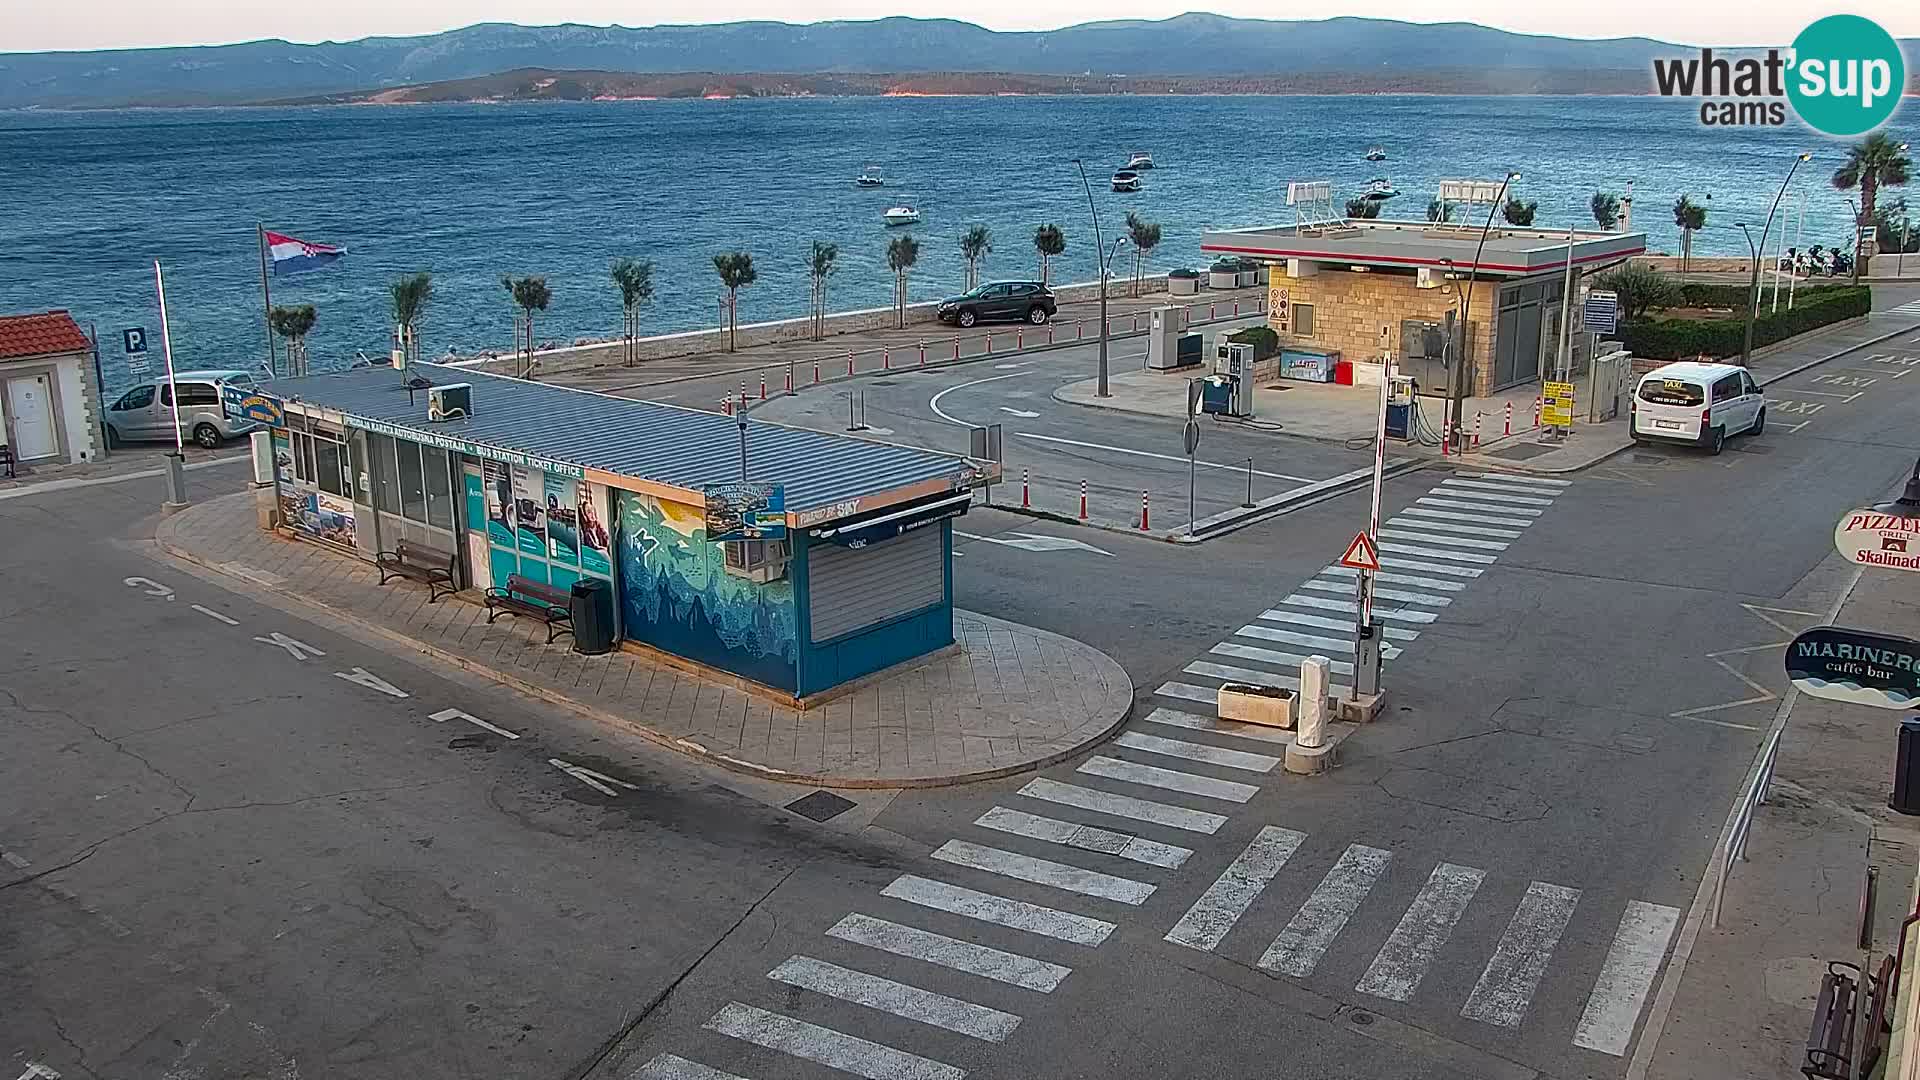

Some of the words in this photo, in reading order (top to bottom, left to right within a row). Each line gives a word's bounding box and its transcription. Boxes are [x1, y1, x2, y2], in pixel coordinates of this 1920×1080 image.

[129, 331, 142, 350] P
[1664, 381, 1682, 389] TAXI
[1810, 374, 1878, 388] TAXI
[395, 427, 434, 444] AUTOBUSNA
[435, 436, 466, 452] POSTAJA
[477, 447, 491, 458] BUS
[492, 450, 525, 465] STATION
[527, 457, 552, 470] TICKET
[554, 463, 580, 477] OFFICE
[1878, 530, 1912, 541] GRILL
[1826, 662, 1863, 675] caffe
[1868, 665, 1894, 680] bar
